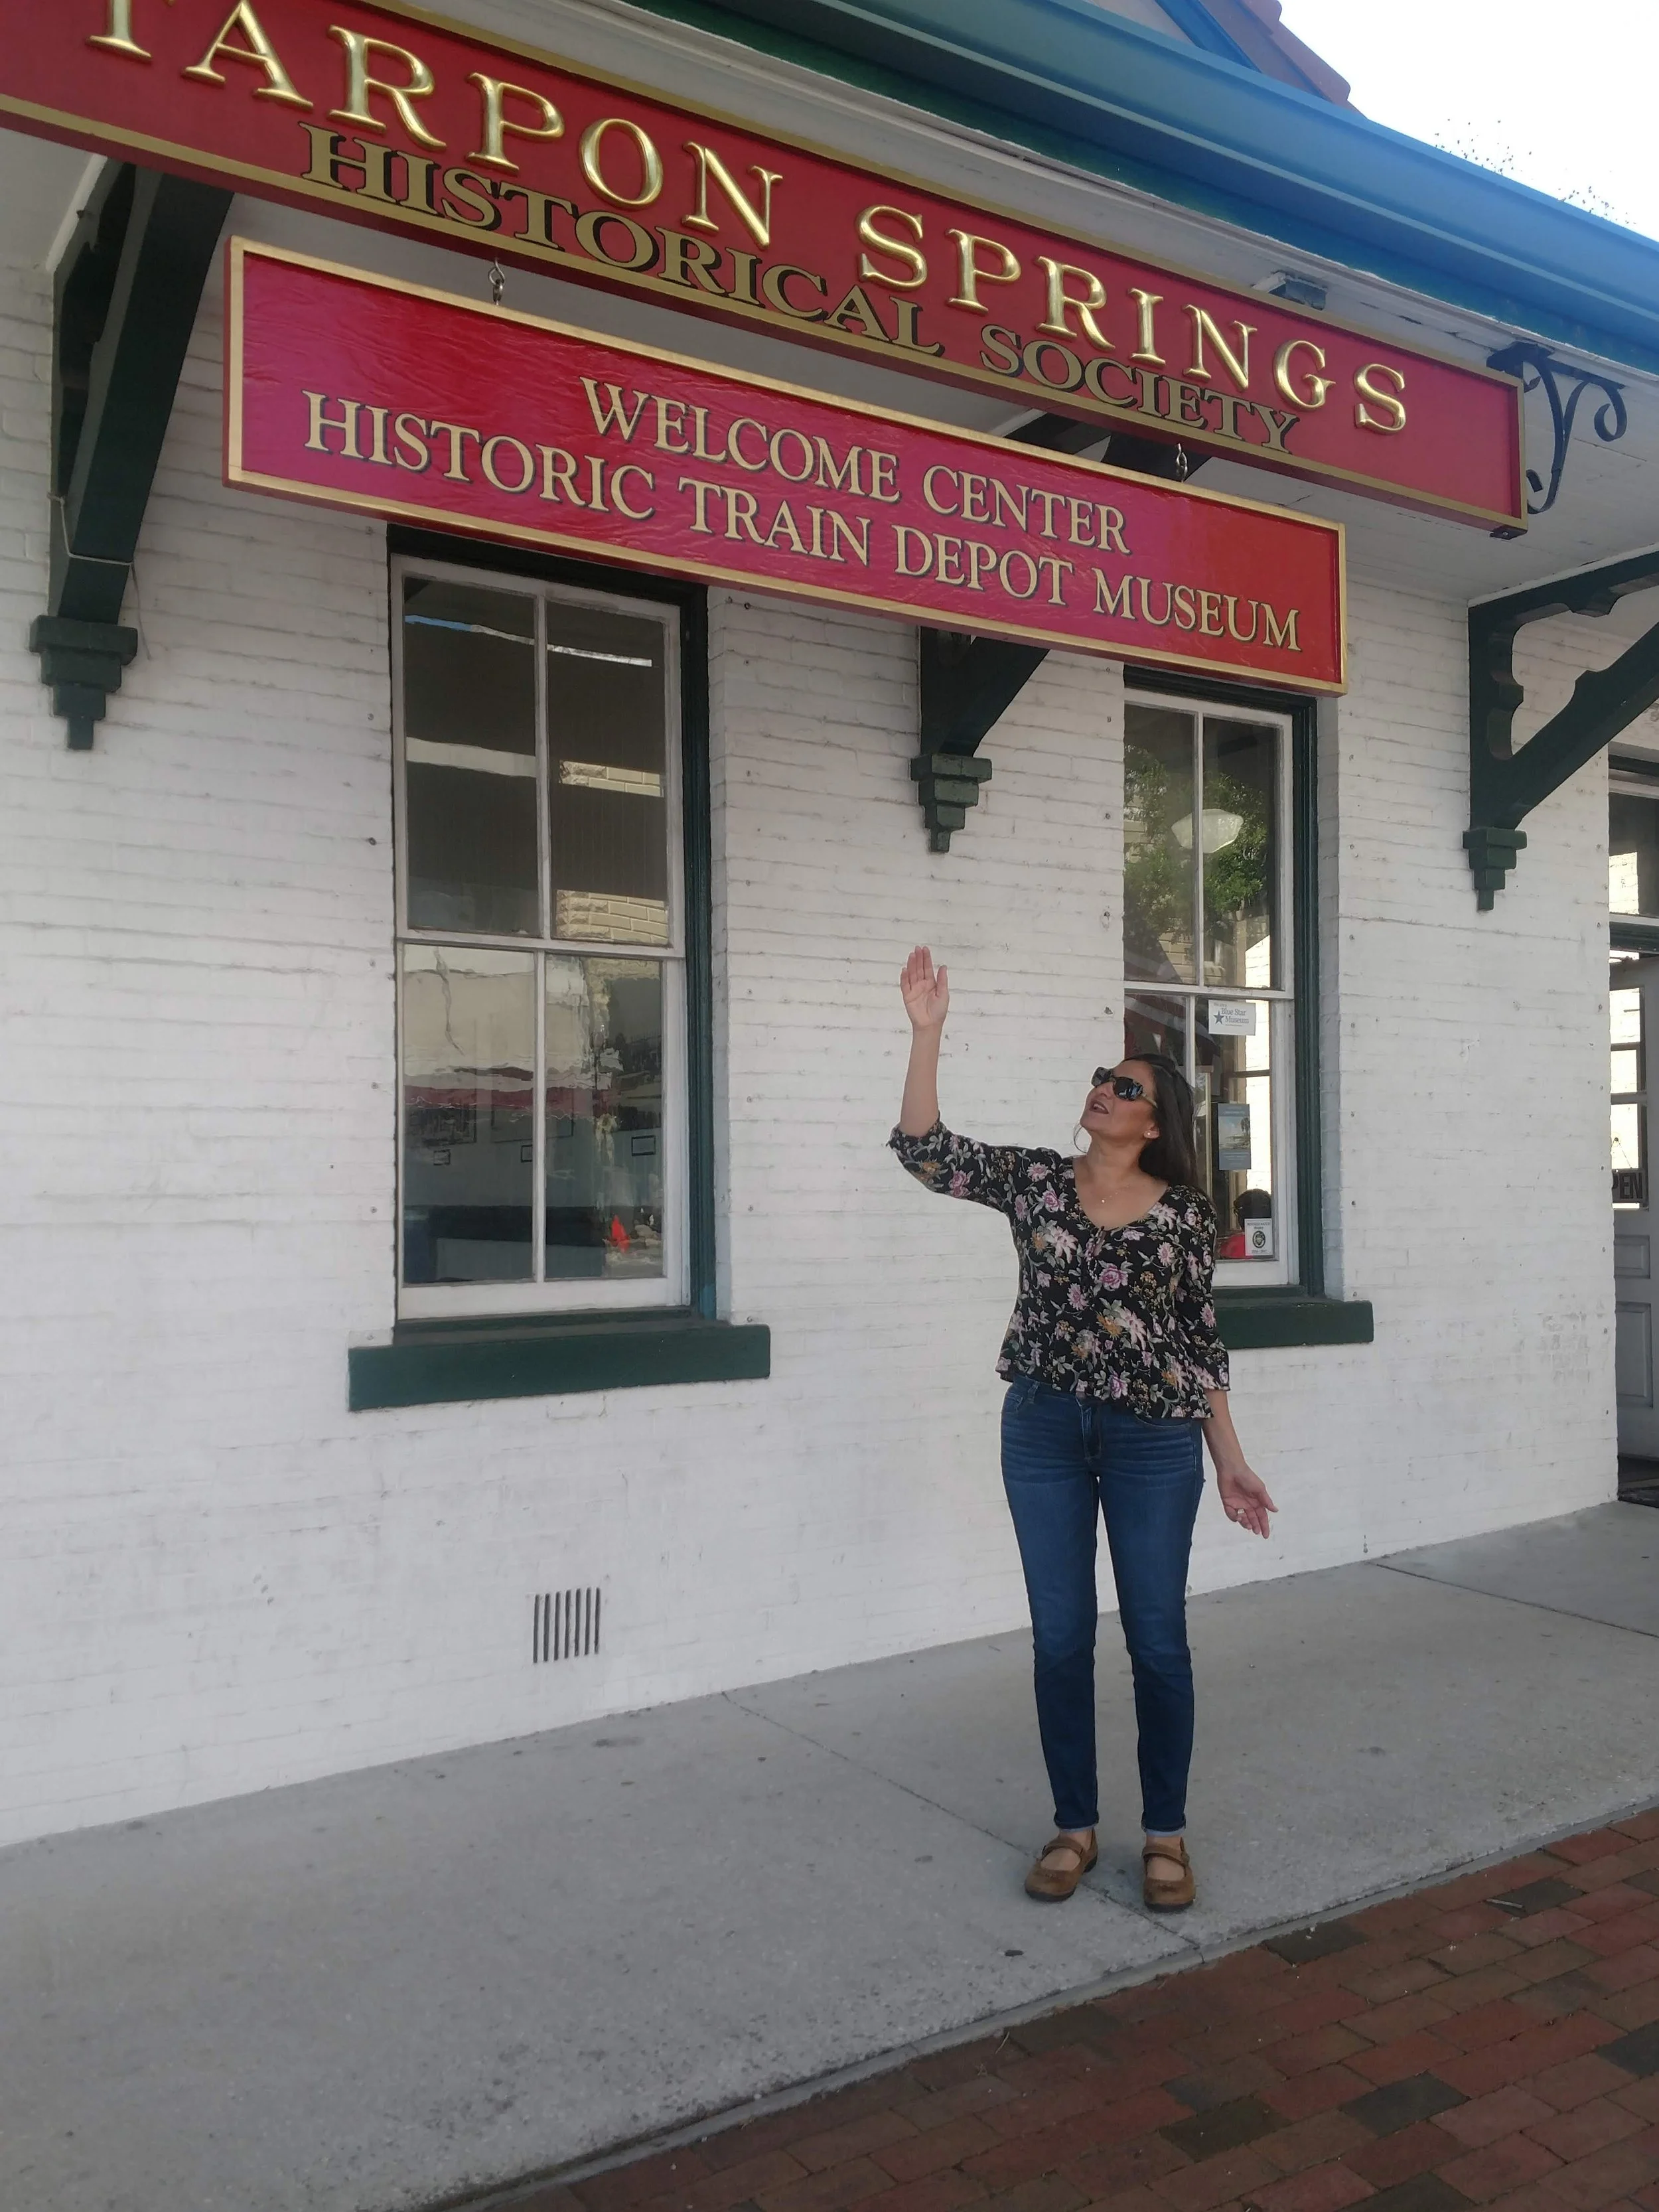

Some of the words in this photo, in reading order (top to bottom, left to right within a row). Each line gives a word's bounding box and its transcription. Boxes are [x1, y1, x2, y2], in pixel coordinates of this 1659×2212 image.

[298, 122, 944, 357] HISTORICAL
[978, 324, 1301, 455] SOCIETY
[857, 204, 1407, 435] SPRINGS
[301, 389, 657, 521] HISTORIC
[677, 477, 871, 567] TRAIN
[894, 524, 1074, 607] DEPOT
[1093, 567, 1303, 652] MUSEUM
[579, 376, 901, 504] WELCOME
[922, 464, 1132, 556] CENTER
[1221, 1007, 1234, 1016] Blue
[1225, 1015, 1250, 1024] Museum
[1611, 1172, 1643, 1199] PEN
